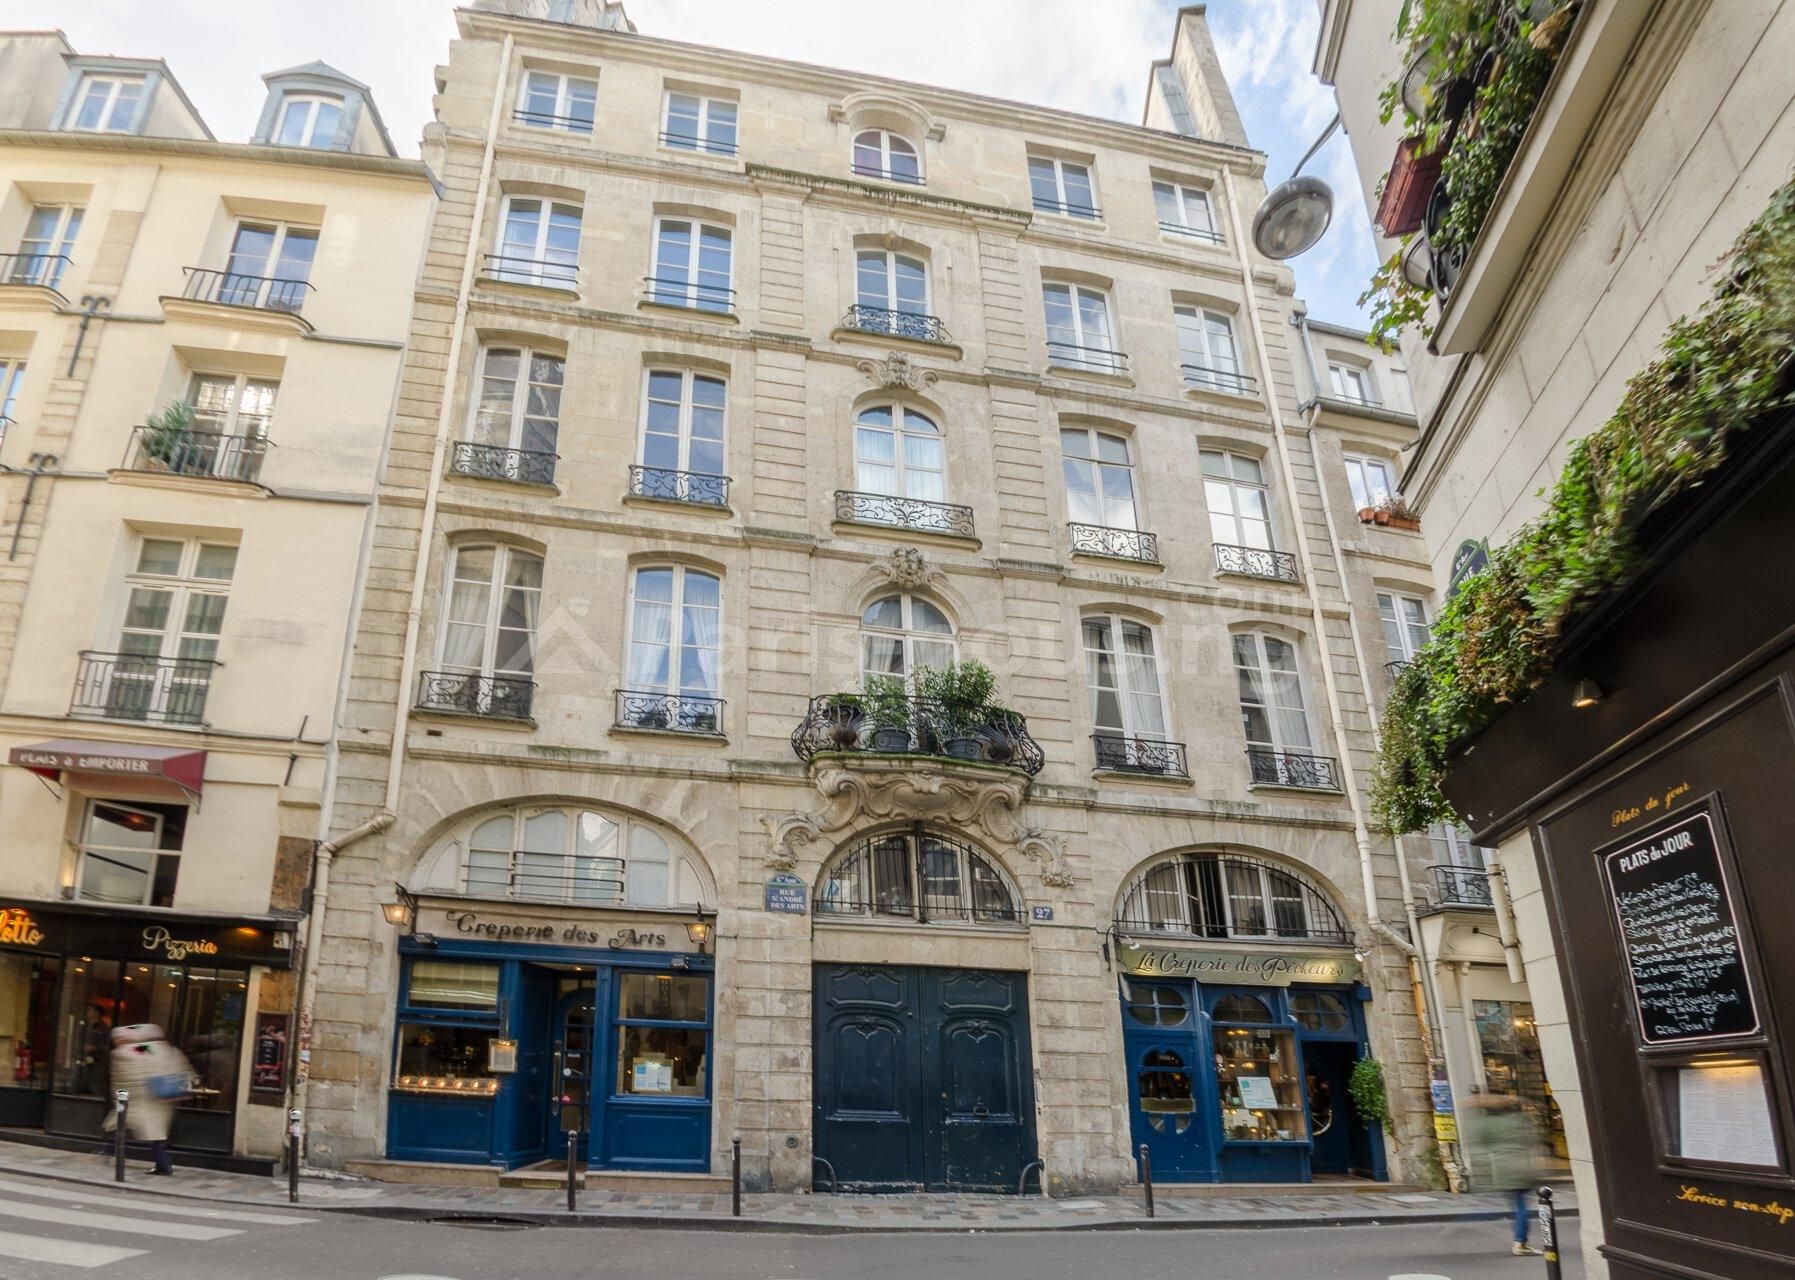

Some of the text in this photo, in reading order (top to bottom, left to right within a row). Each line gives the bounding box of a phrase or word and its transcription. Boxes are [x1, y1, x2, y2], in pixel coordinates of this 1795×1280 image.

[1611, 807, 1640, 828] Plats
[1645, 797, 1659, 811] du
[1619, 831, 1694, 873] PLATS du JOUR
[779, 889, 796, 897] RUE
[1036, 907, 1050, 919] 27
[142, 925, 218, 960] Pizzeria
[562, 924, 600, 944] des
[608, 928, 666, 950] Arts
[1159, 952, 1230, 974] Crêperie
[1236, 955, 1260, 972] des
[1676, 1184, 1727, 1208] Service
